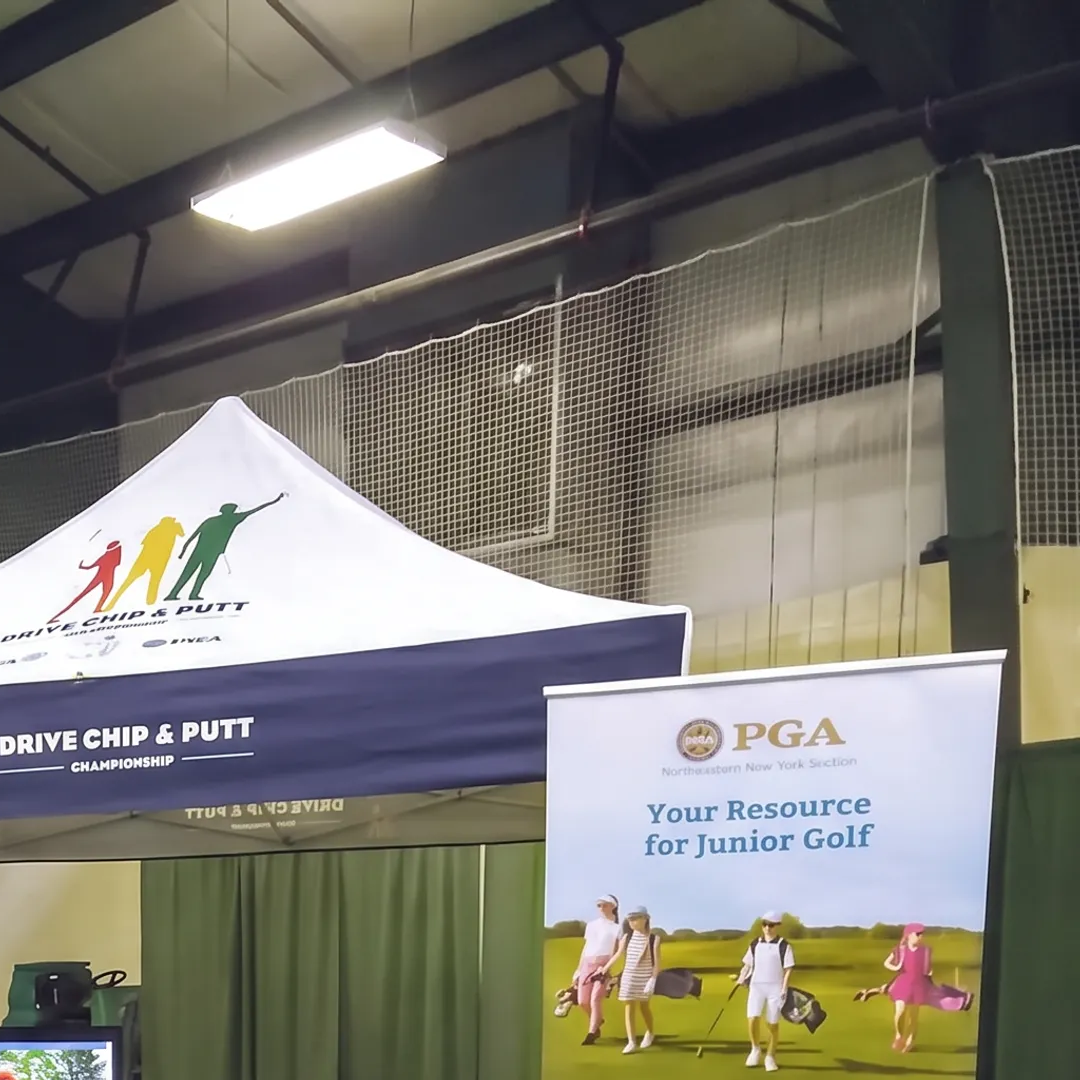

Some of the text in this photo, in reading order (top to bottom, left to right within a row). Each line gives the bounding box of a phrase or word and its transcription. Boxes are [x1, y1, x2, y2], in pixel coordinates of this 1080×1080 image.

[0, 621, 78, 643] DRIVE
[81, 610, 146, 628] CHIP
[150, 608, 168, 618] &
[175, 601, 250, 616] PUTT
[82, 724, 150, 750] CHIP
[155, 723, 174, 745] &
[182, 717, 255, 742] PUTT
[732, 717, 846, 752] PGA
[70, 754, 175, 773] CHAMPIONSHIP
[777, 759, 805, 770] York
[647, 797, 872, 824] Your Resource
[644, 824, 875, 859] for Junior Golf
